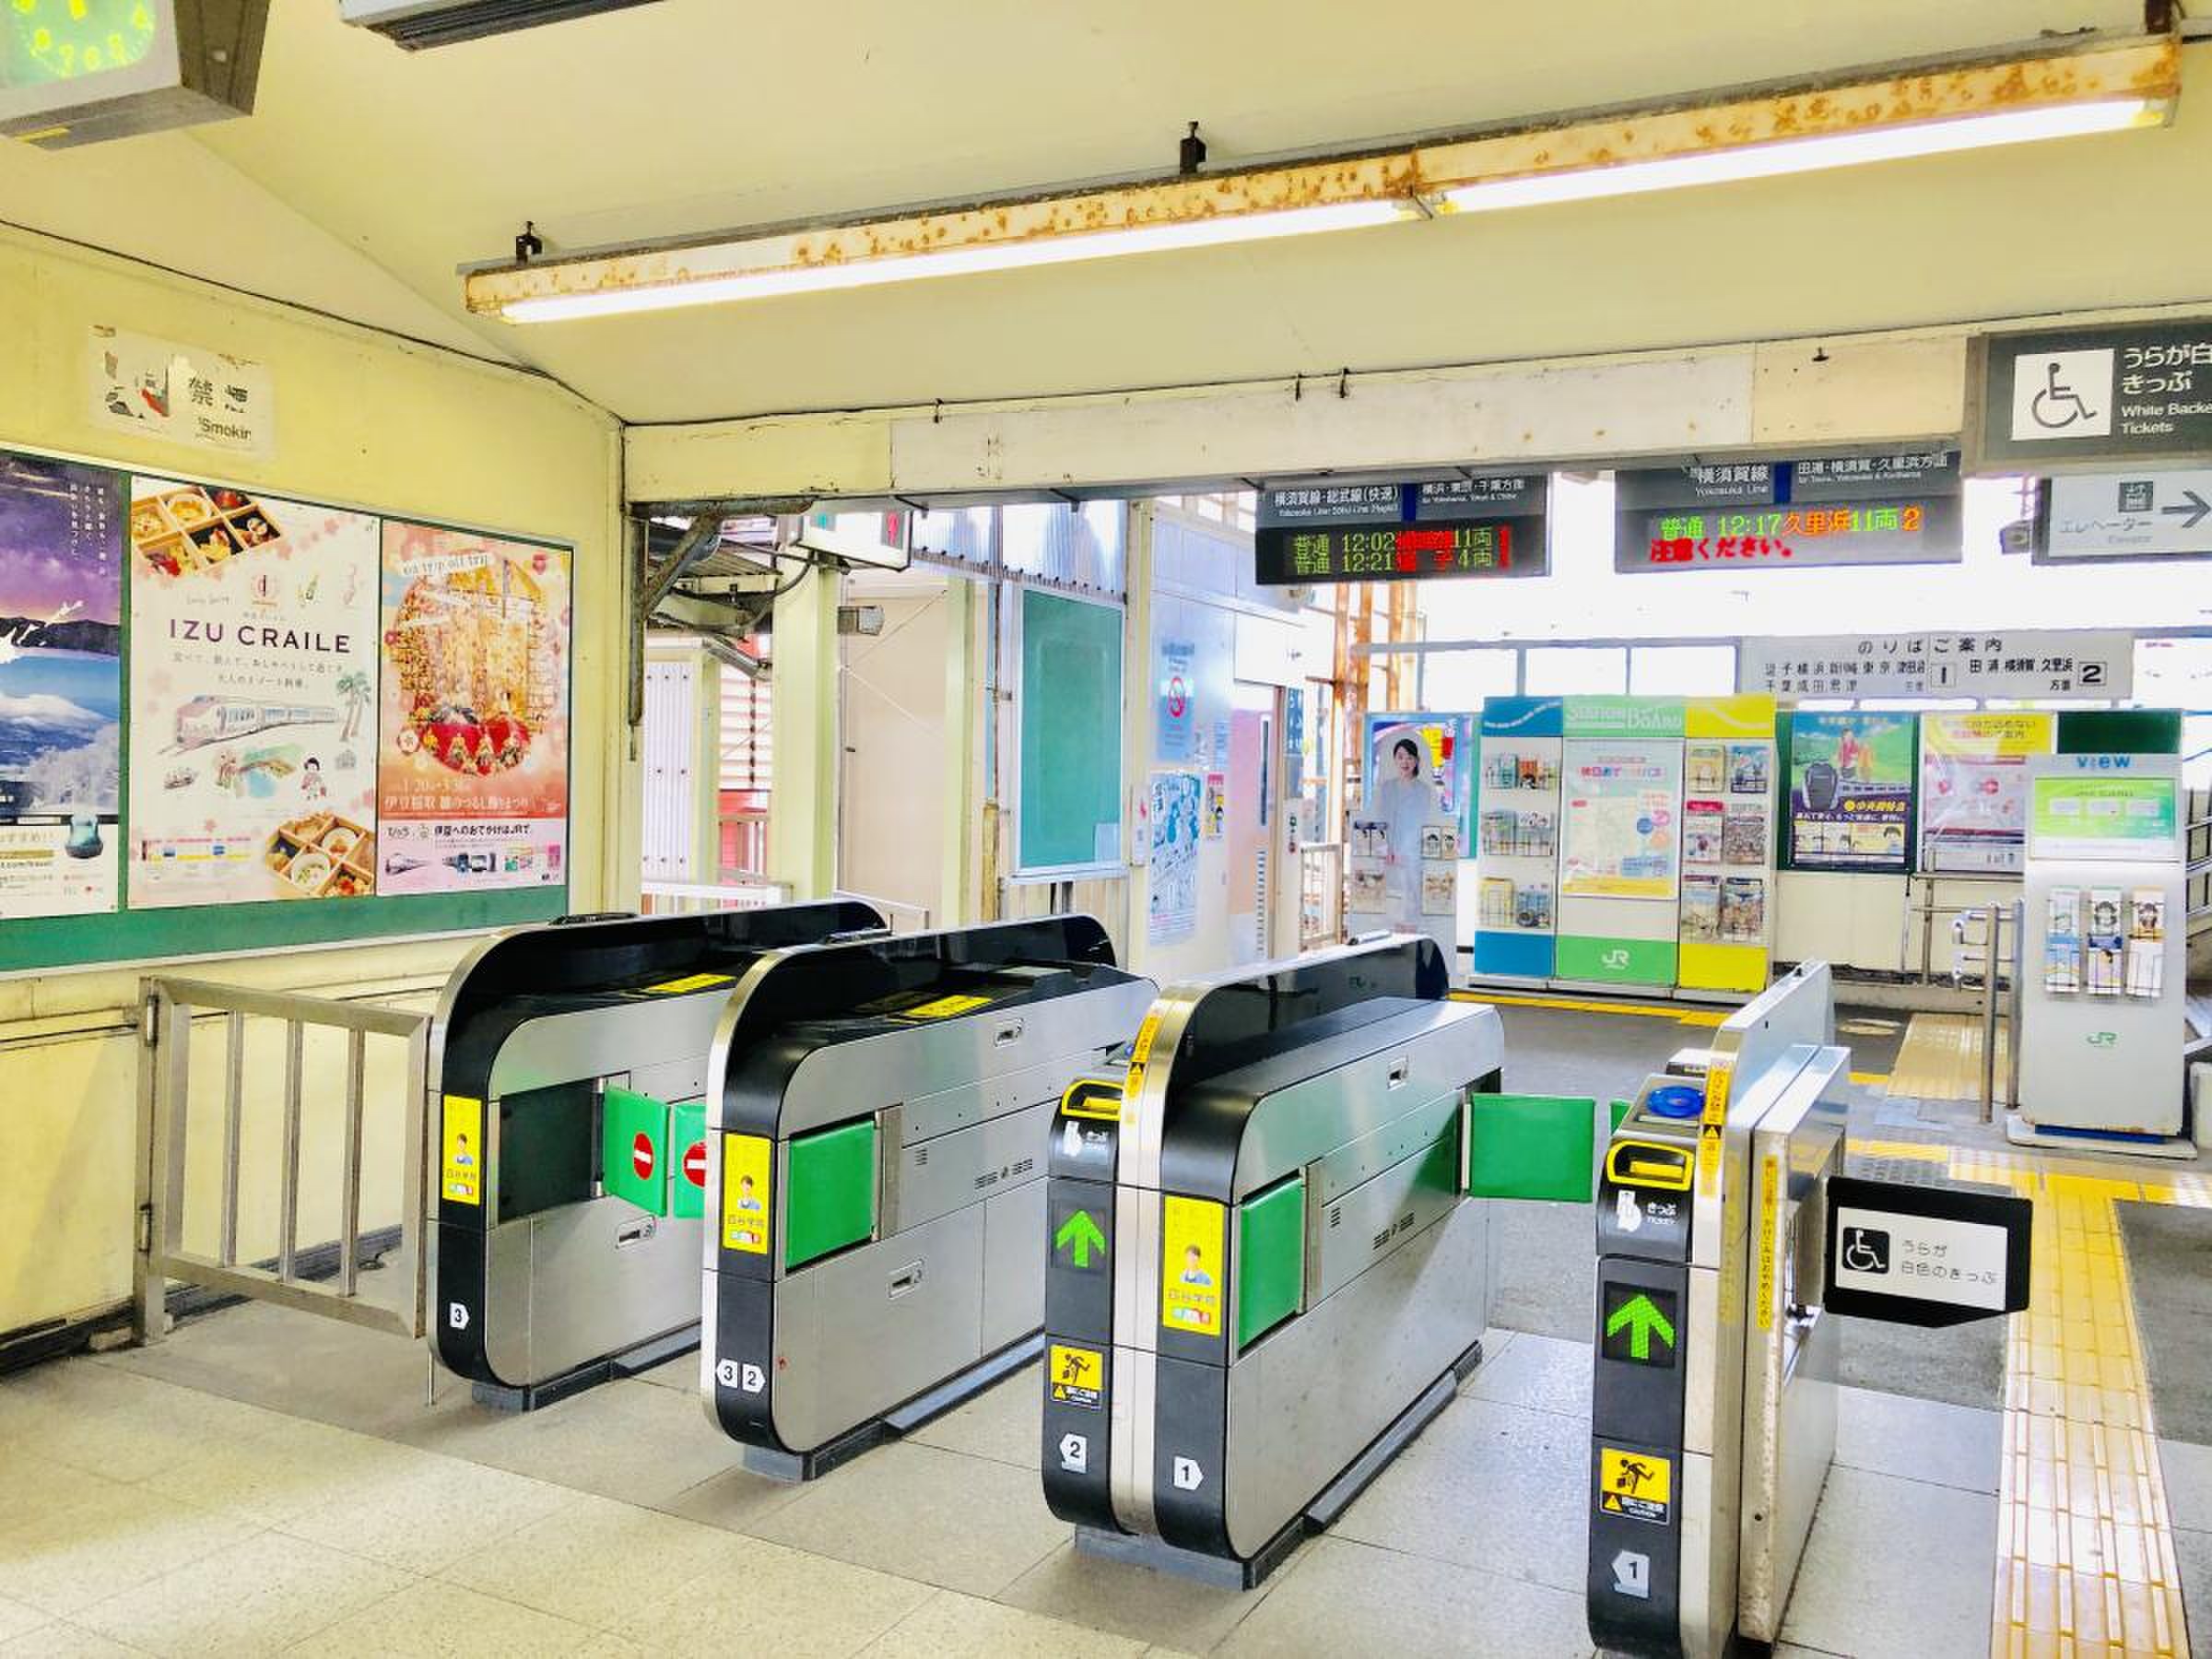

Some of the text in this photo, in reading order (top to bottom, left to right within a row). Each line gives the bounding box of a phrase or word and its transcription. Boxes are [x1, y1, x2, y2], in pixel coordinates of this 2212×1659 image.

[2122, 371, 2193, 394] きっぷ
[2122, 404, 2164, 418] White
[2122, 421, 2174, 435] Tickets
[1697, 465, 1770, 484] 横須賀線
[1661, 515, 1703, 540] 普通
[1718, 513, 1782, 537] 12:17
[1902, 506, 1923, 531] 2
[1294, 535, 1330, 554] 普通
[1341, 532, 1395, 552] 12:02
[1294, 555, 1330, 575] 普通
[1341, 553, 1394, 573] 12:21
[170, 618, 351, 653] IZU CRAILE
[1858, 638, 2002, 654] のりばご案内
[2082, 665, 2101, 683] 2
[1601, 949, 1630, 964] JR
[2087, 1031, 2118, 1045] JR
[1901, 1262, 1997, 1285] 白色のきっぷ
[453, 1308, 463, 1323] 3
[724, 1365, 735, 1381] 3
[747, 1371, 758, 1386] 2
[1069, 1441, 1081, 1459] 2
[1181, 1465, 1190, 1482] 1
[1629, 1560, 1638, 1579] 1
